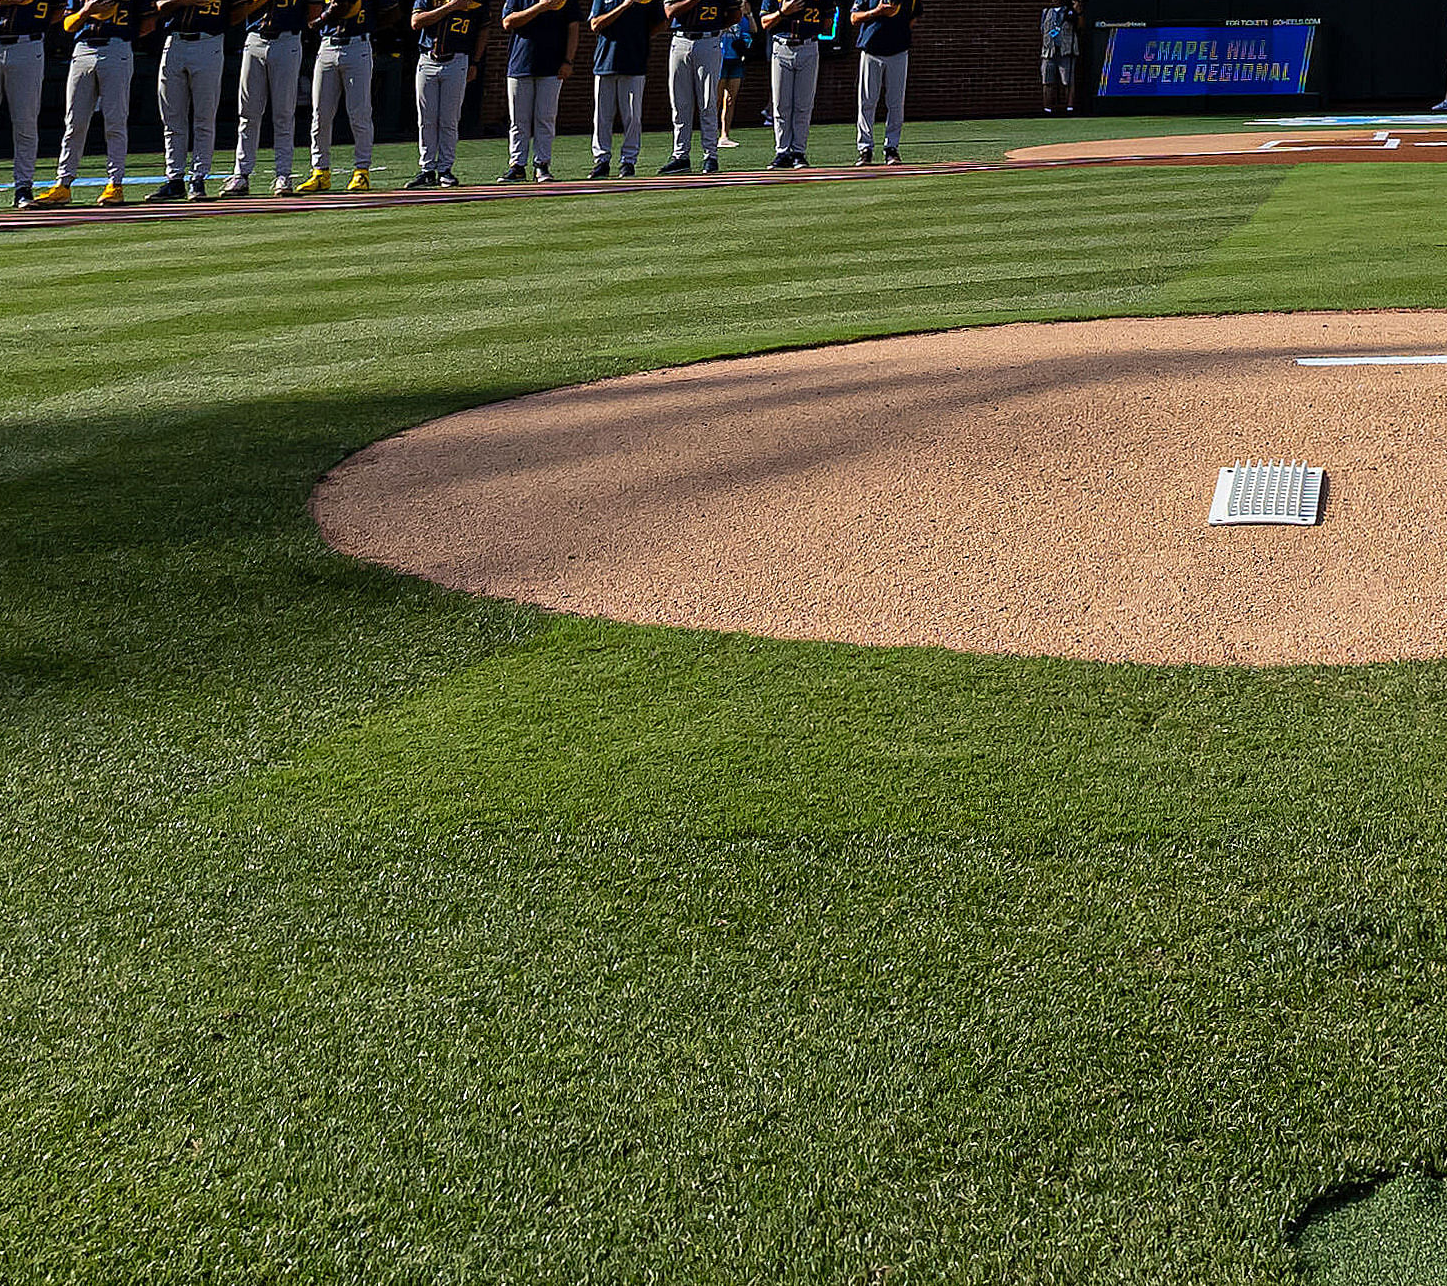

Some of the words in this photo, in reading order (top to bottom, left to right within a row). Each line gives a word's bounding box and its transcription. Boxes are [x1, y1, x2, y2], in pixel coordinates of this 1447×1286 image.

[700, 6, 717, 20] 29
[804, 8, 821, 23] 22
[450, 17, 471, 34] 28
[1143, 41, 1218, 61] CHAPEL
[1227, 40, 1267, 60] HILL
[1119, 64, 1187, 84] SUPER
[1193, 62, 1291, 82] REGIONAL
